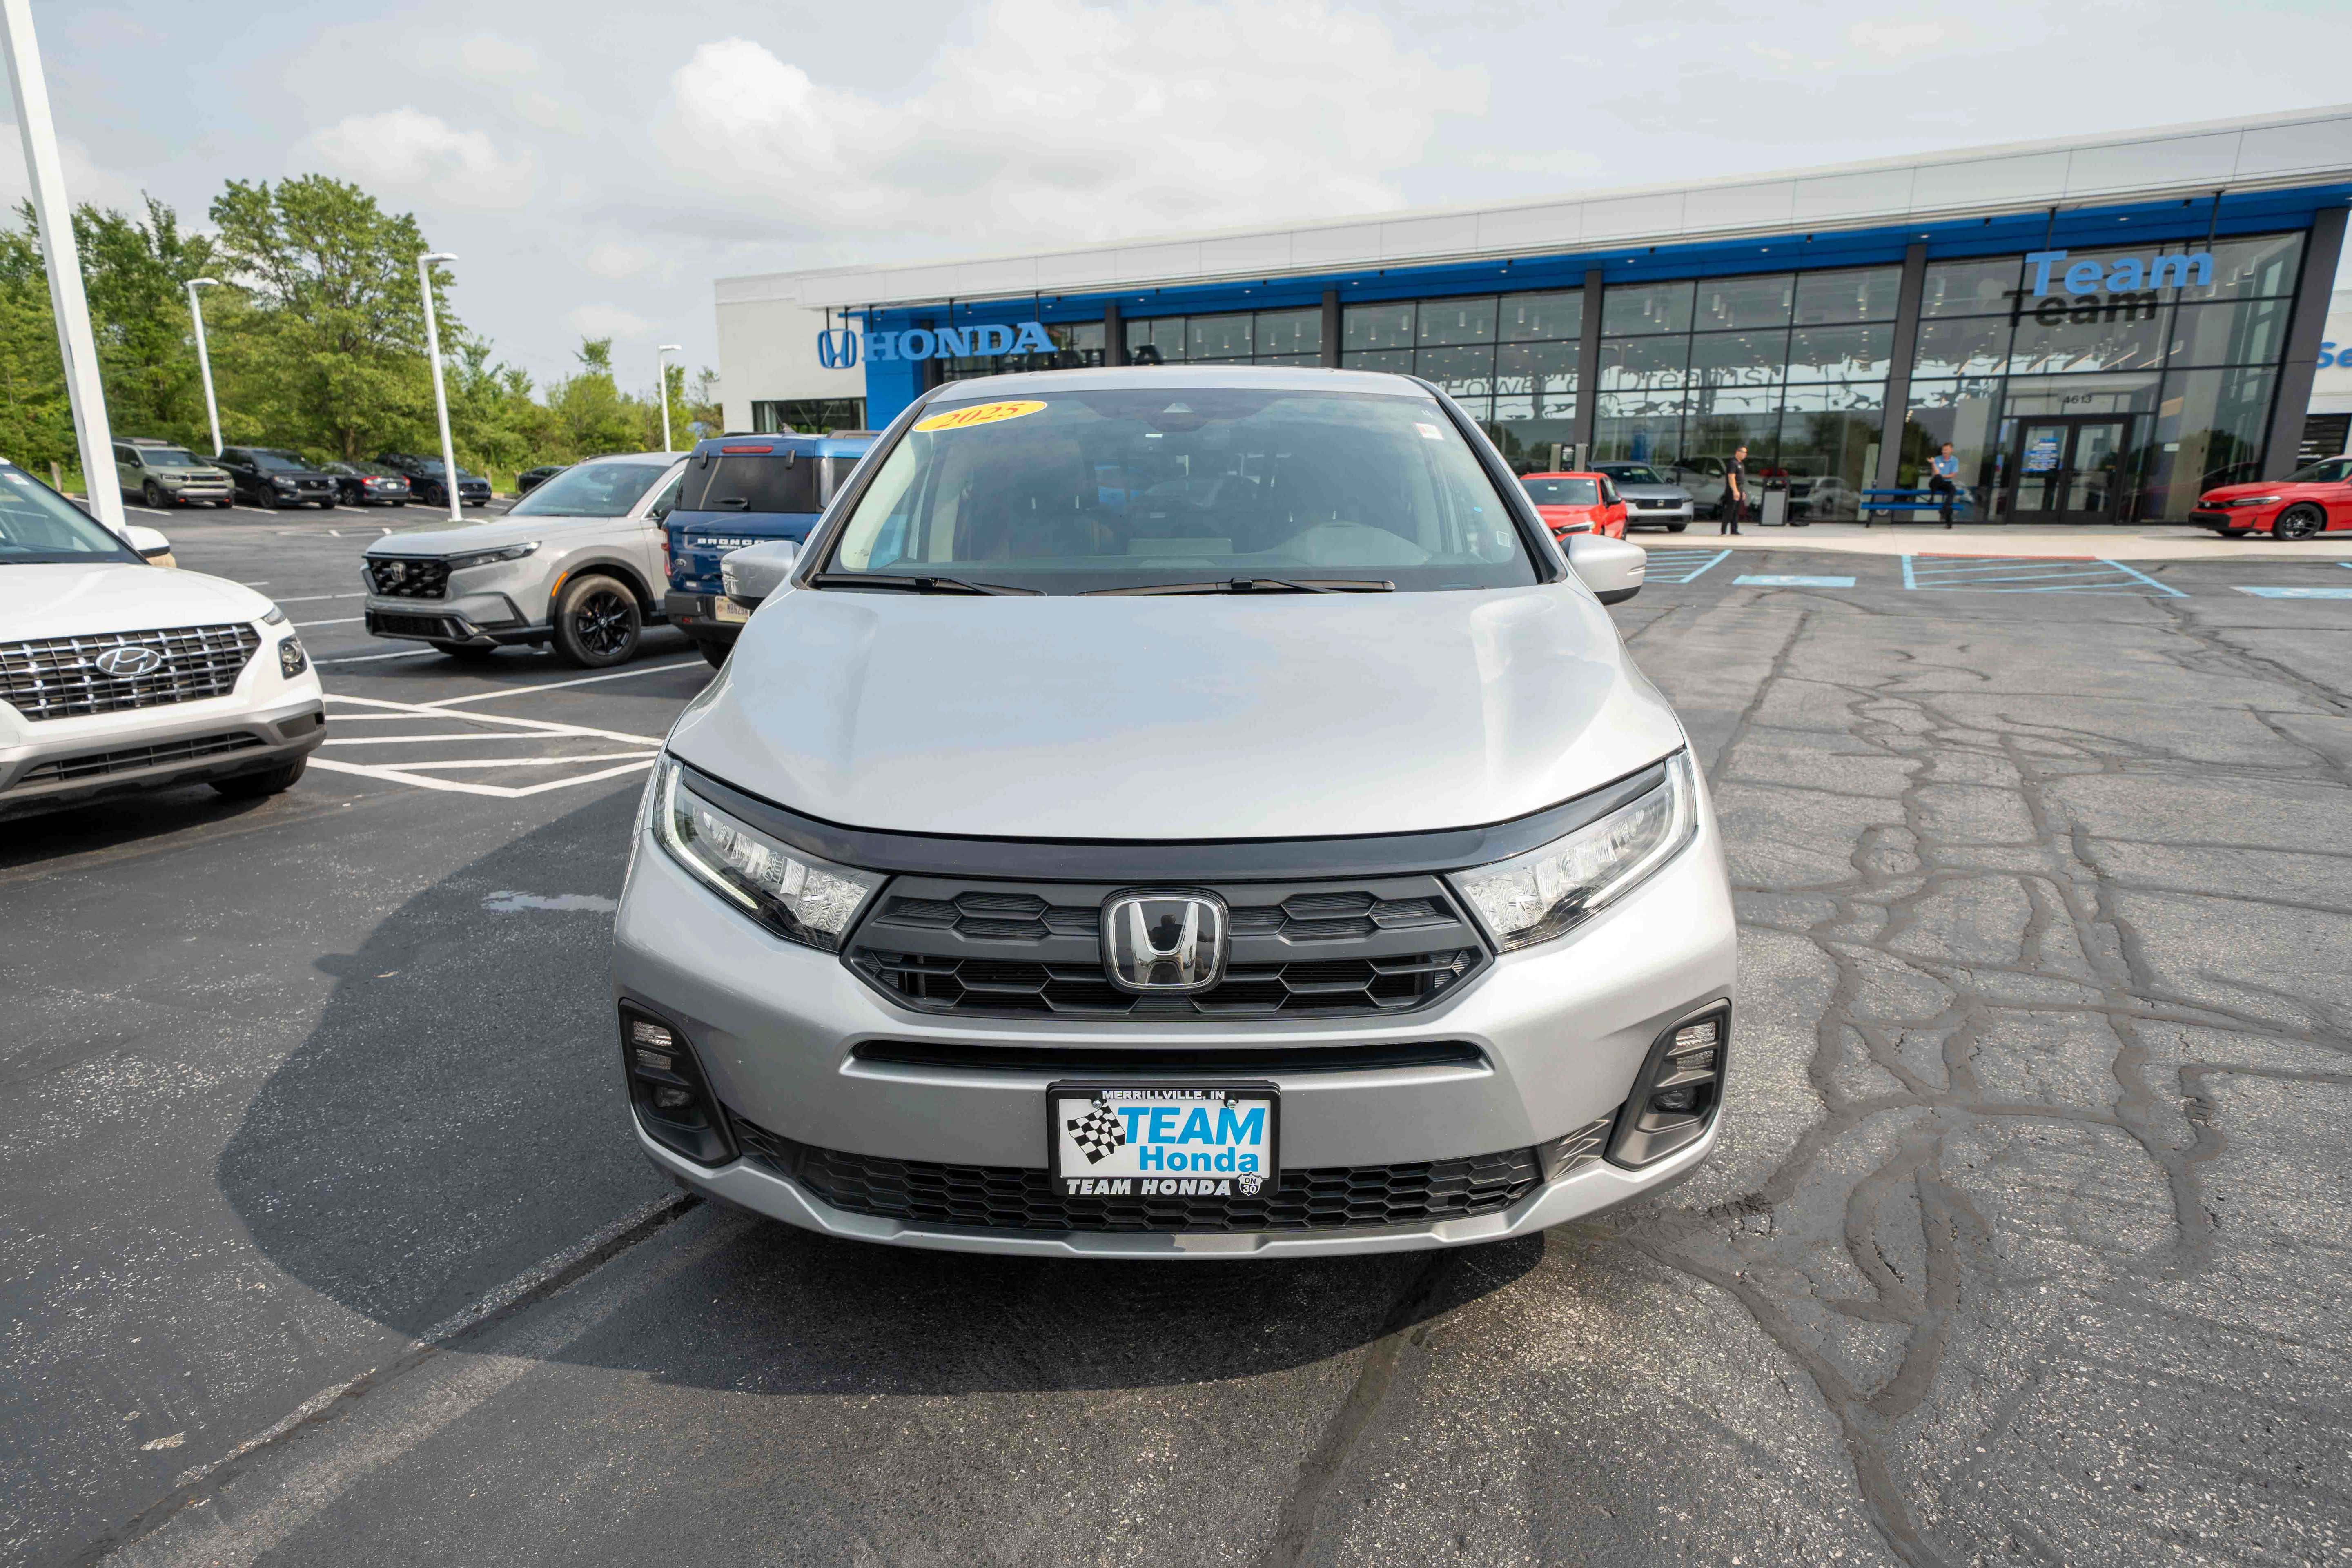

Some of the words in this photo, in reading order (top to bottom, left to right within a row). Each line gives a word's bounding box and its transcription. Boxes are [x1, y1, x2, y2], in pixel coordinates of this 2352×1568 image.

[2026, 250, 2214, 297] Team
[861, 321, 1058, 362] HONDA
[2062, 395, 2092, 404] 4613
[933, 403, 1026, 429] 2025
[697, 537, 765, 546] BRONCO
[1102, 1091, 1207, 1101] MERRILLVILLE,
[1210, 1091, 1225, 1100] IN
[1118, 1107, 1265, 1145] TEAM
[1139, 1145, 1259, 1172] Honda
[1067, 1179, 1131, 1195] TEAM
[1141, 1179, 1231, 1196] HONDA
[1243, 1184, 1256, 1193] 30
